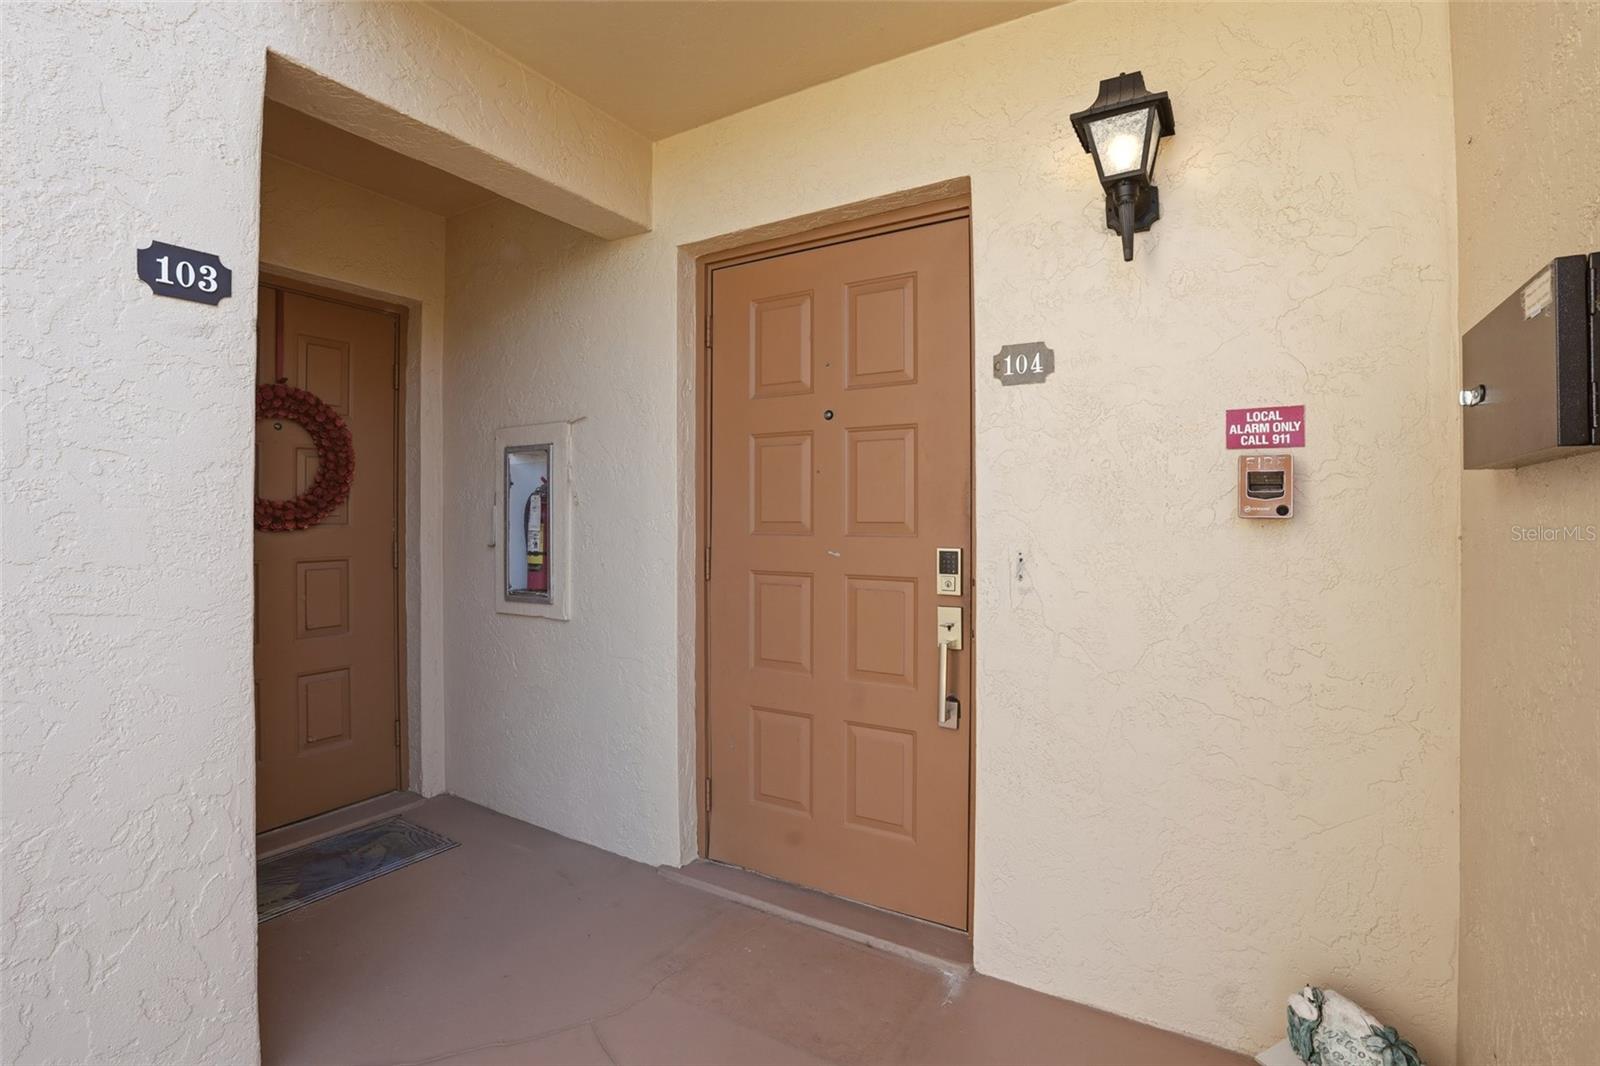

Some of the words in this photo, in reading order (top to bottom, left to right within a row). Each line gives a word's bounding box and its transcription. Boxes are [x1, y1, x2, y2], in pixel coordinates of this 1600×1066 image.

[155, 255, 219, 293] 103
[1003, 351, 1044, 376] 104
[1246, 410, 1283, 422] LOCAL
[1229, 422, 1270, 435] ALARM
[1272, 421, 1302, 433] ONLY
[1240, 434, 1270, 446] CALL
[1272, 433, 1291, 445] 911
